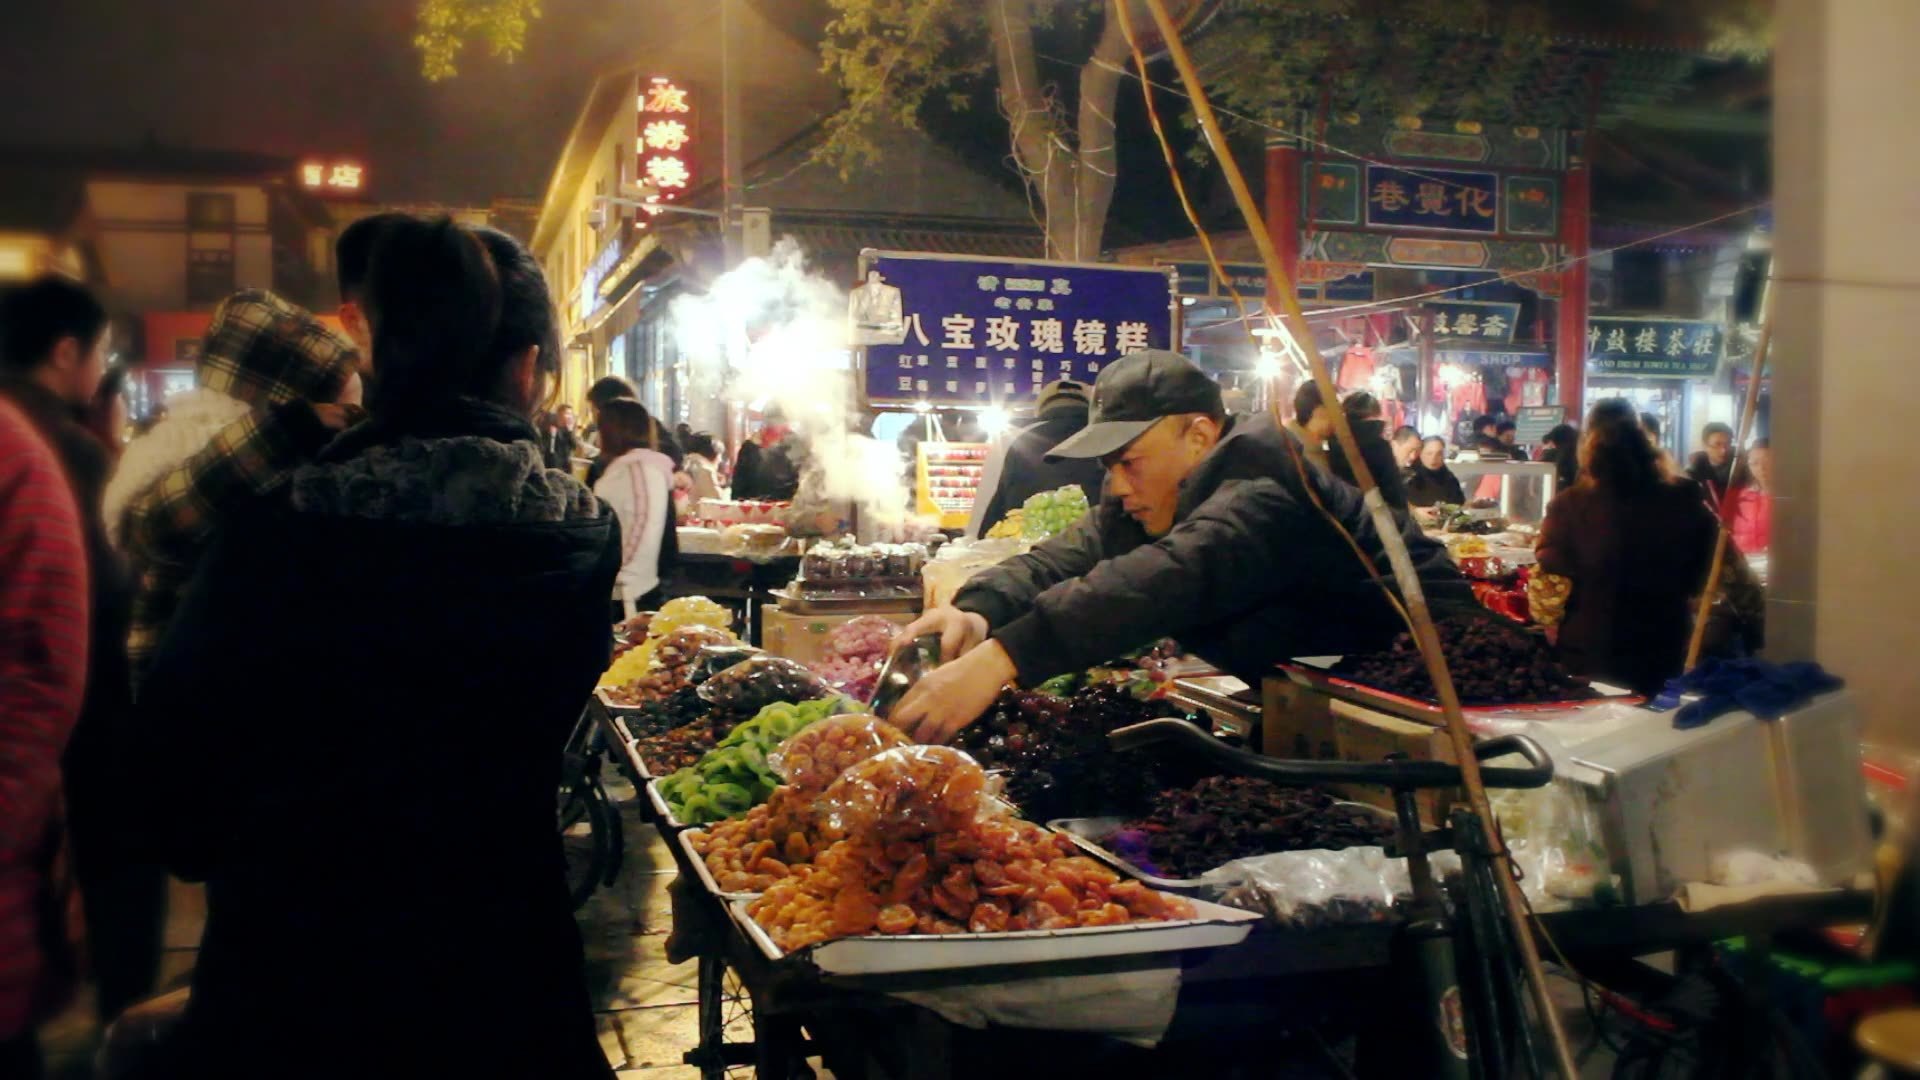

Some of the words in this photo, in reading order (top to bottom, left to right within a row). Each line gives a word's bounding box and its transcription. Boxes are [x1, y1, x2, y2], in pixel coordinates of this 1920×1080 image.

[902, 312, 1149, 356] 八宝玫瑰镜糕
